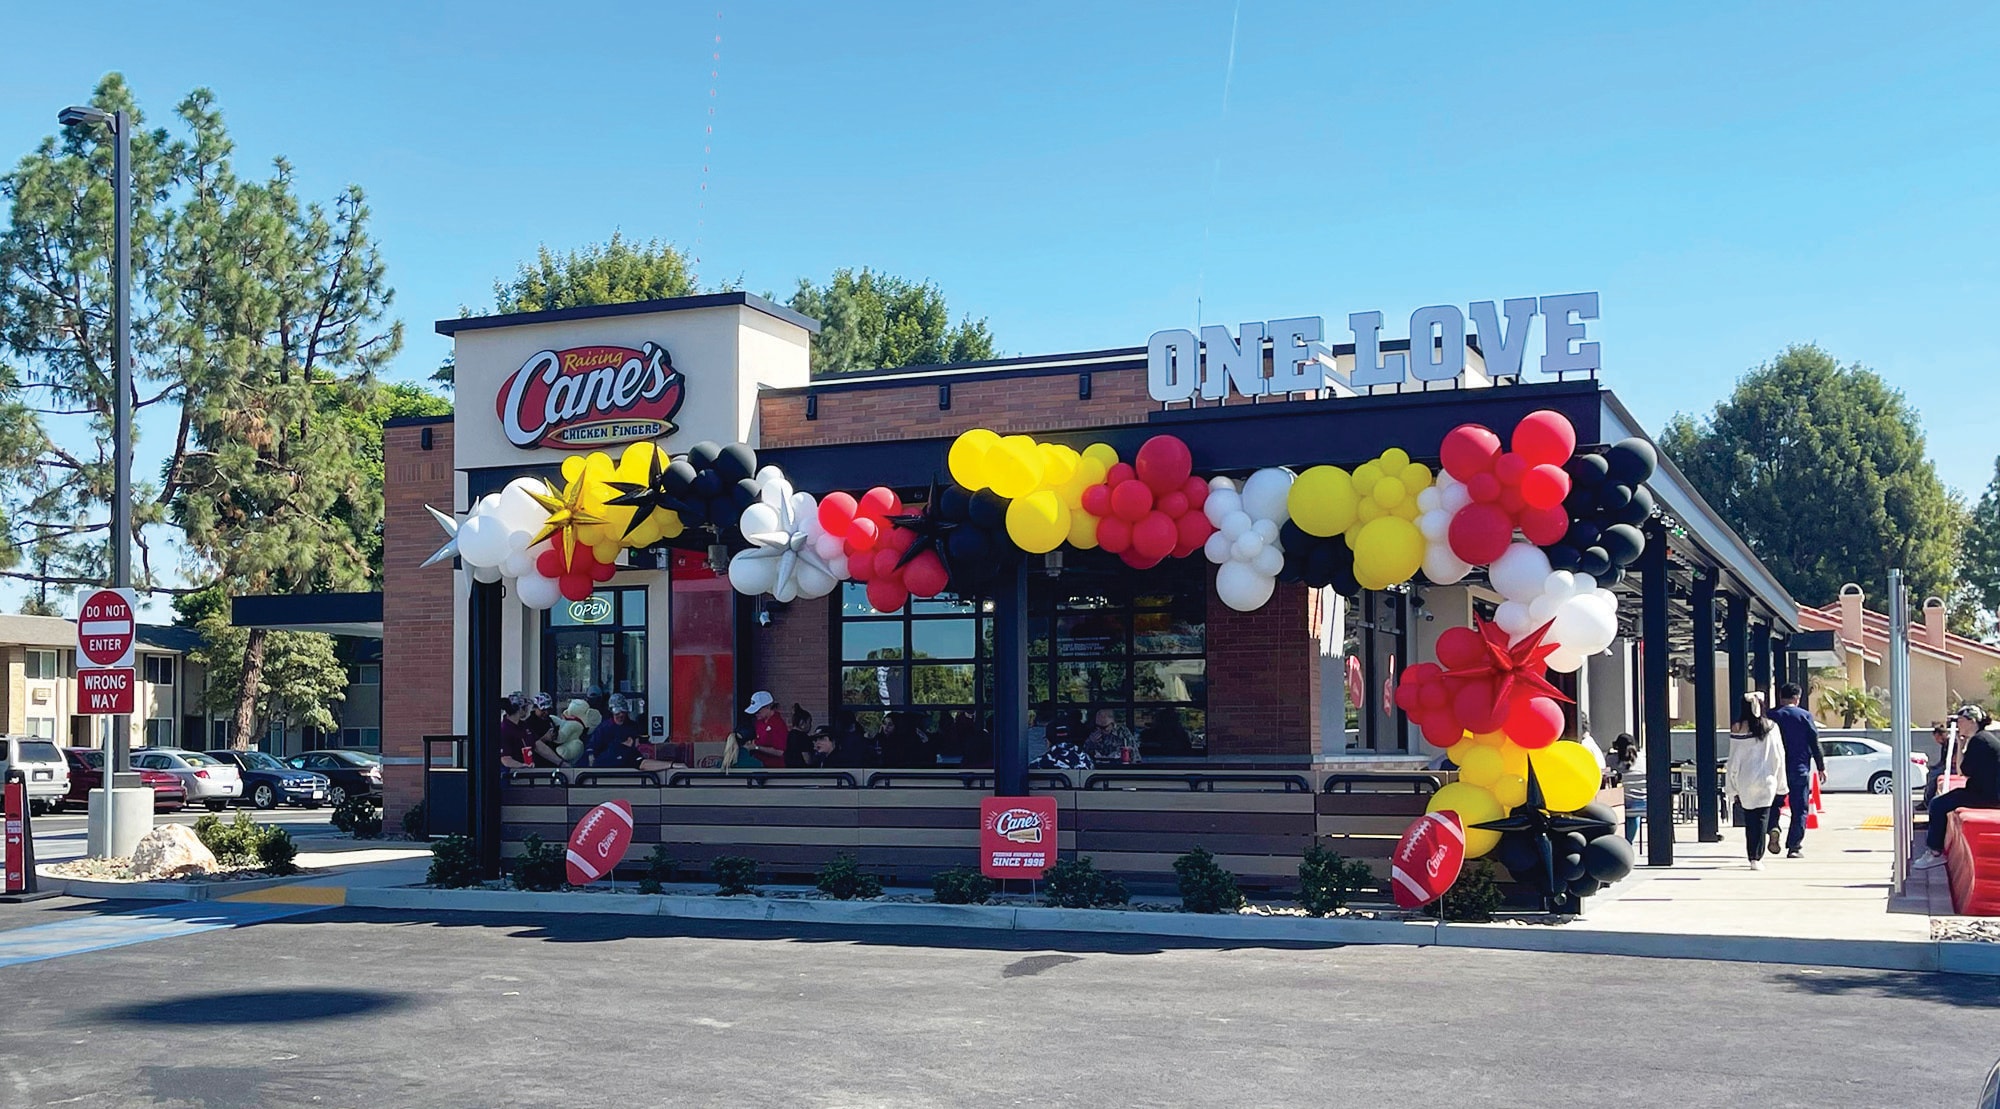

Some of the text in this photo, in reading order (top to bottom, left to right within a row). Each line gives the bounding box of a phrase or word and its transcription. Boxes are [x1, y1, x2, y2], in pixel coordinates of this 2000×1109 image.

[1147, 291, 1601, 402] ONE LOVE
[563, 350, 623, 373] Raising
[502, 341, 677, 446] Cane's
[562, 423, 661, 440] CHICKEN FINGERS
[86, 604, 126, 618] DO NOT
[573, 603, 608, 617] OPEN
[89, 639, 121, 651] ENTER
[84, 674, 127, 690] WRONG
[91, 693, 118, 709] WAY
[996, 811, 1041, 835] Cane's
[992, 857, 1045, 867] SINCE 1996
